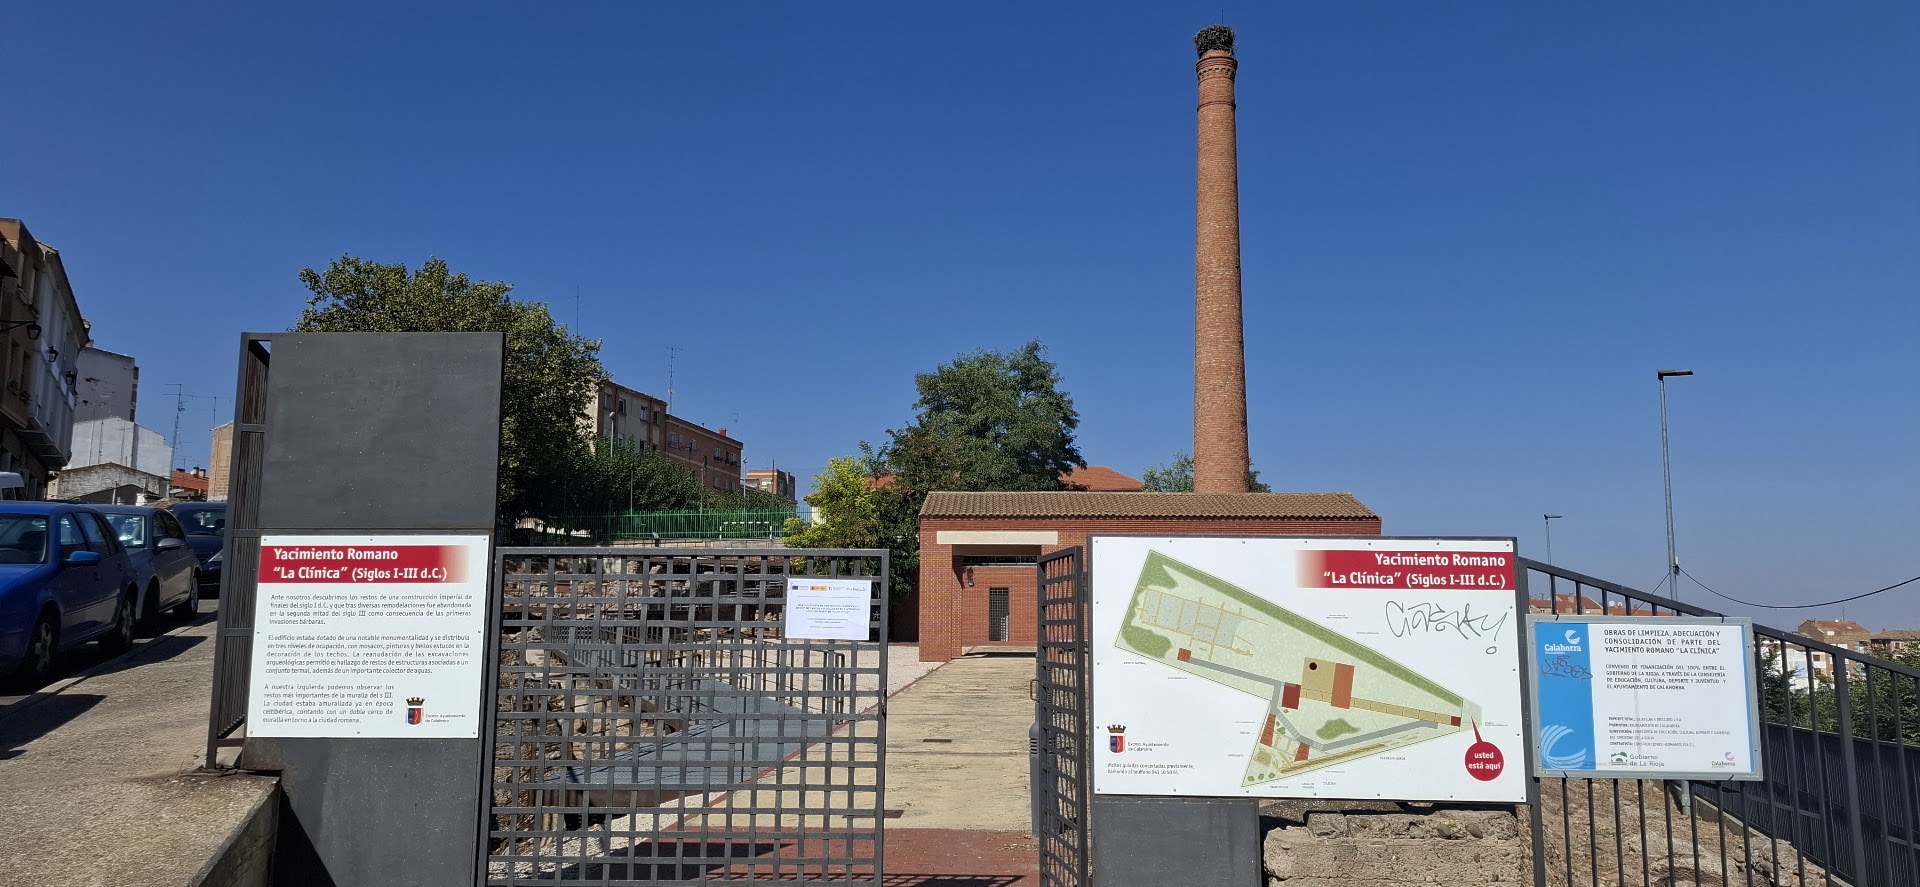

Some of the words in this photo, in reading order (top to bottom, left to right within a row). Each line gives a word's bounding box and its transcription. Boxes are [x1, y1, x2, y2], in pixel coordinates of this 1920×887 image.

[273, 547, 344, 560] Yacimiento
[347, 548, 398, 560] Romano
[1374, 553, 1449, 566] Yacimiento
[1452, 553, 1506, 567] Romano
[273, 566, 295, 579] “La
[298, 566, 348, 579] Clínica”
[352, 567, 391, 582] (Siglos
[393, 567, 418, 579] I-III
[420, 567, 447, 582] d.C.)
[1323, 571, 1347, 584] “La
[1349, 571, 1401, 585] Clínica”
[1406, 573, 1447, 588] (Siglos
[1449, 574, 1475, 586] I-III
[1477, 574, 1506, 589] d.C.)
[439, 593, 463, 601] imperial
[381, 601, 426, 609] remodelaciones
[1637, 629, 1672, 637] LIMPIEZA,
[1604, 637, 1662, 645] CONSOLIDACIÓN
[1544, 643, 1582, 652] Calahorra
[1689, 647, 1720, 655] CLÍNICA”
[363, 650, 402, 658] reanudación
[265, 667, 291, 675] conjunto
[297, 683, 324, 691] izquierda
[1468, 762, 1484, 770] está
[1485, 762, 1501, 771] aquí
